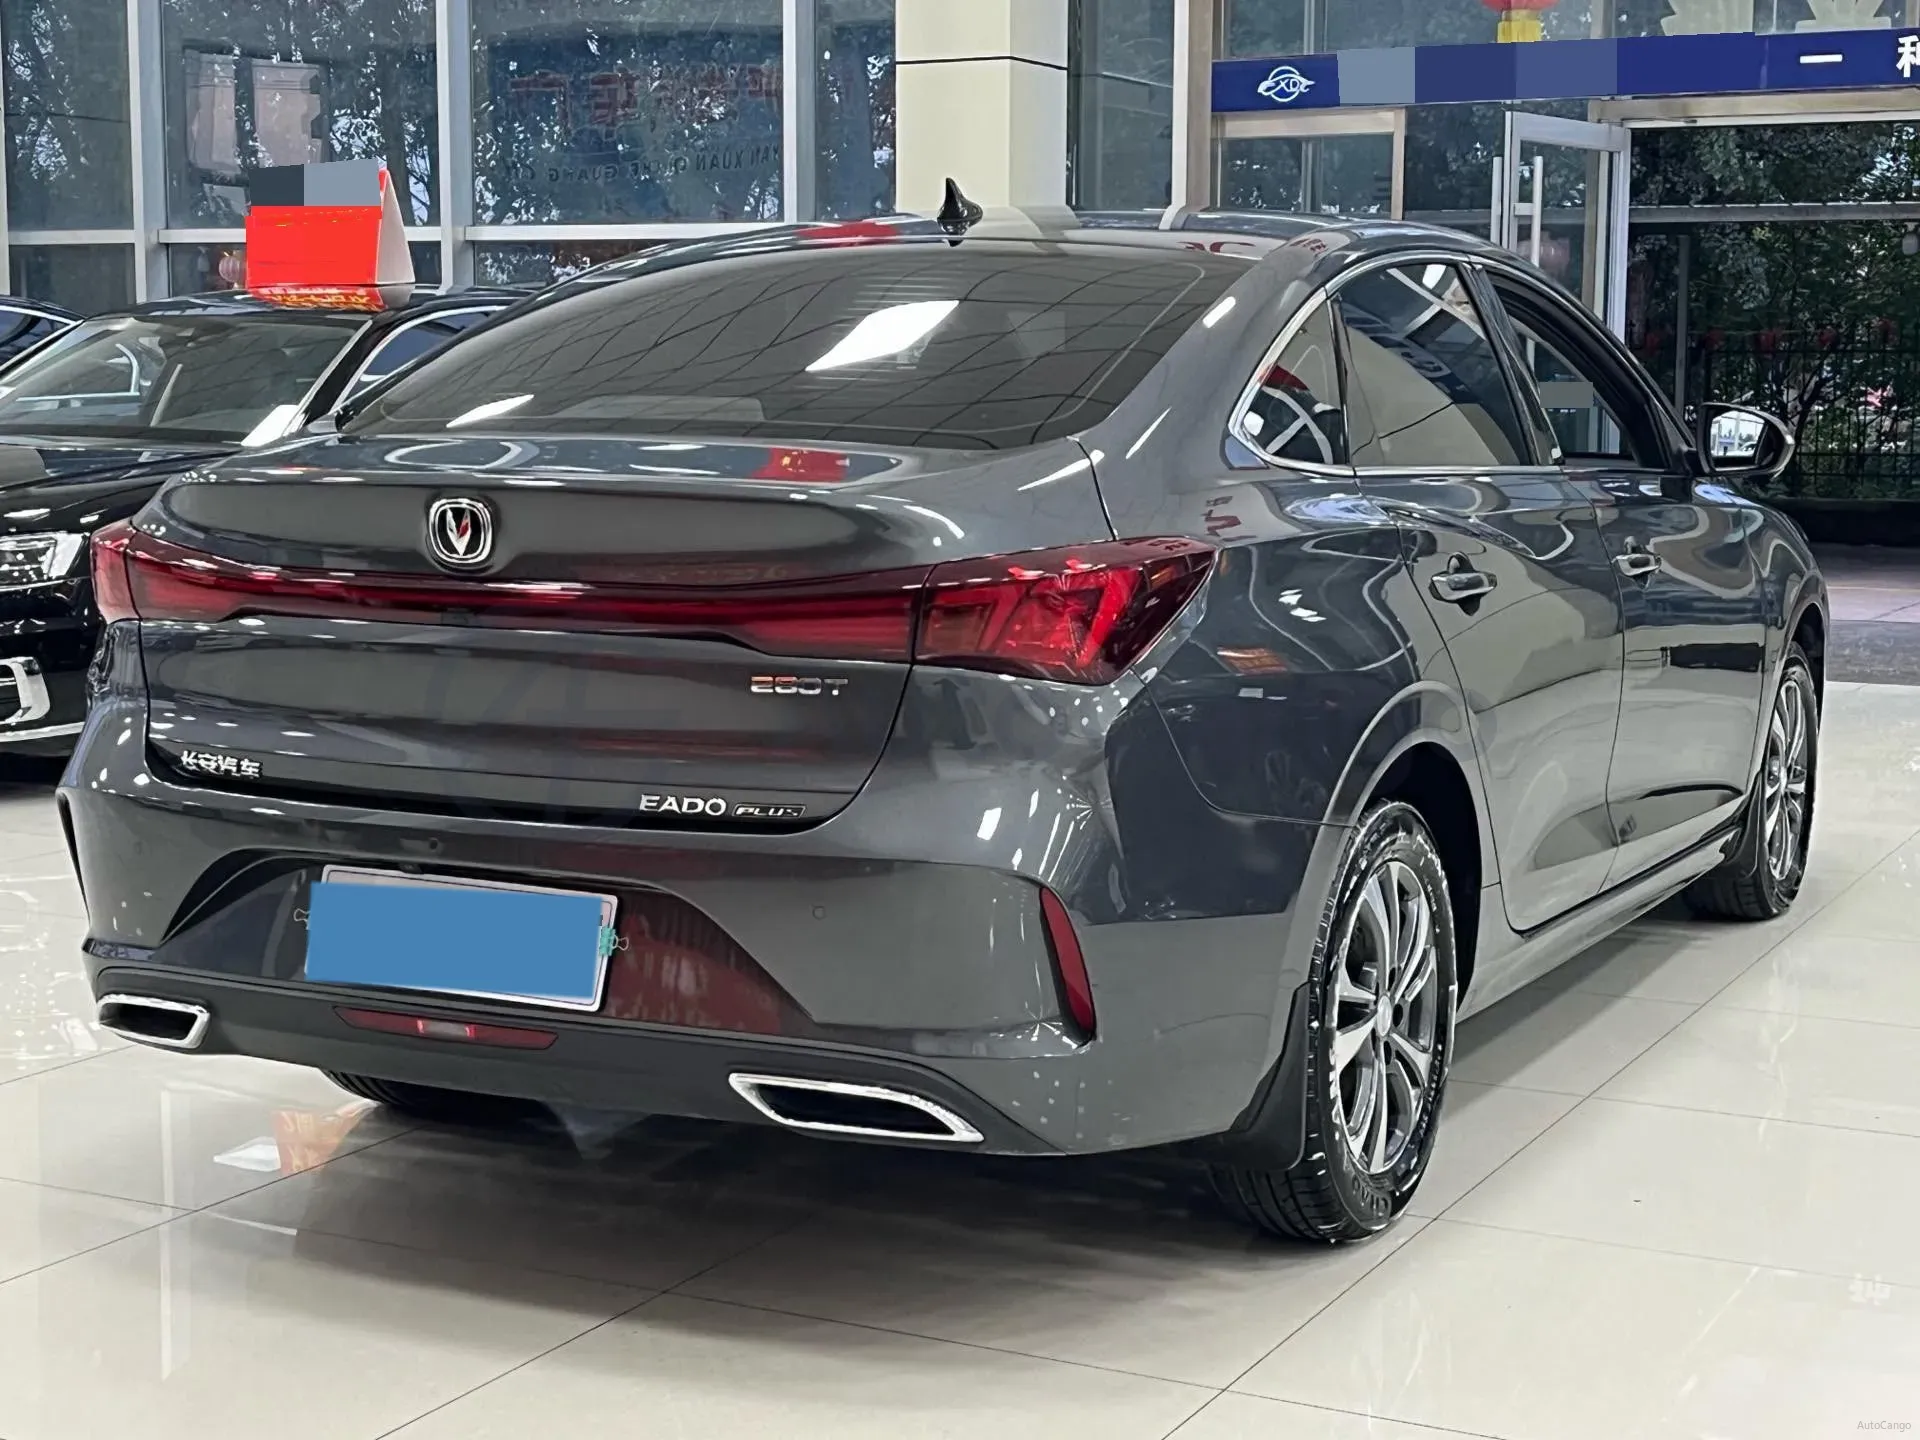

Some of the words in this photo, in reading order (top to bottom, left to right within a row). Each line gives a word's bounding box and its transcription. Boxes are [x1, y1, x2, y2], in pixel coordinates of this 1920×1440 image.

[180, 750, 261, 779] 长安汽车
[639, 794, 727, 816] EADO
[735, 805, 799, 816] PLUS
